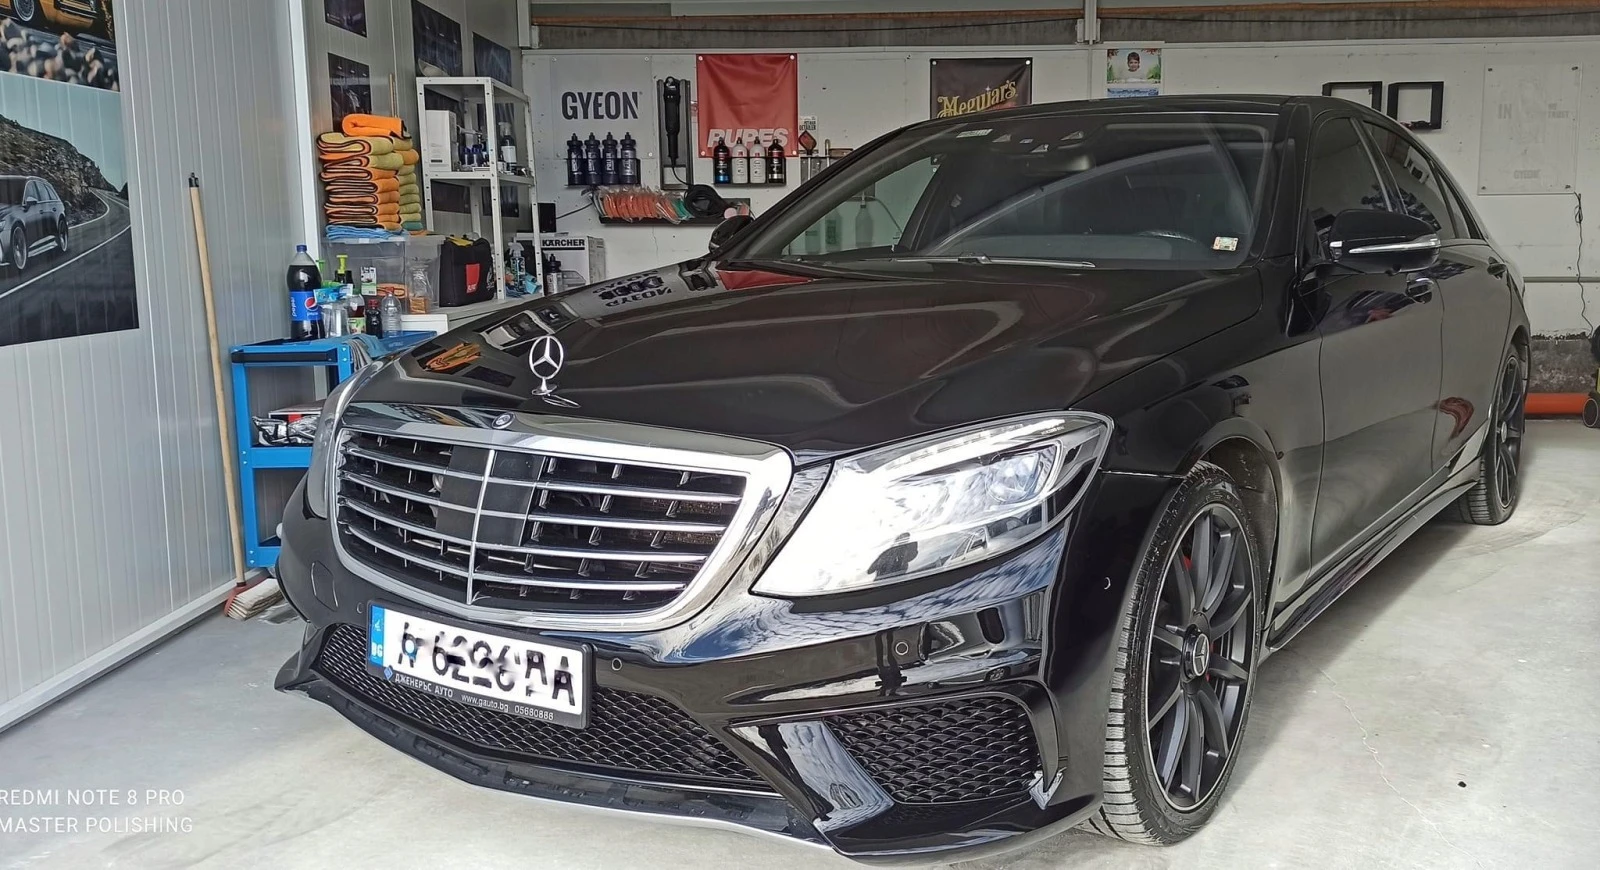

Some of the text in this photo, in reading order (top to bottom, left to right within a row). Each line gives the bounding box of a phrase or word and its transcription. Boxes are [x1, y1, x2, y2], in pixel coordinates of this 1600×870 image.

[561, 91, 639, 120] GYEON
[936, 80, 1016, 119] Meguiar's
[434, 686, 454, 698] АУТО
[461, 693, 510, 713] www.gauto.bg
